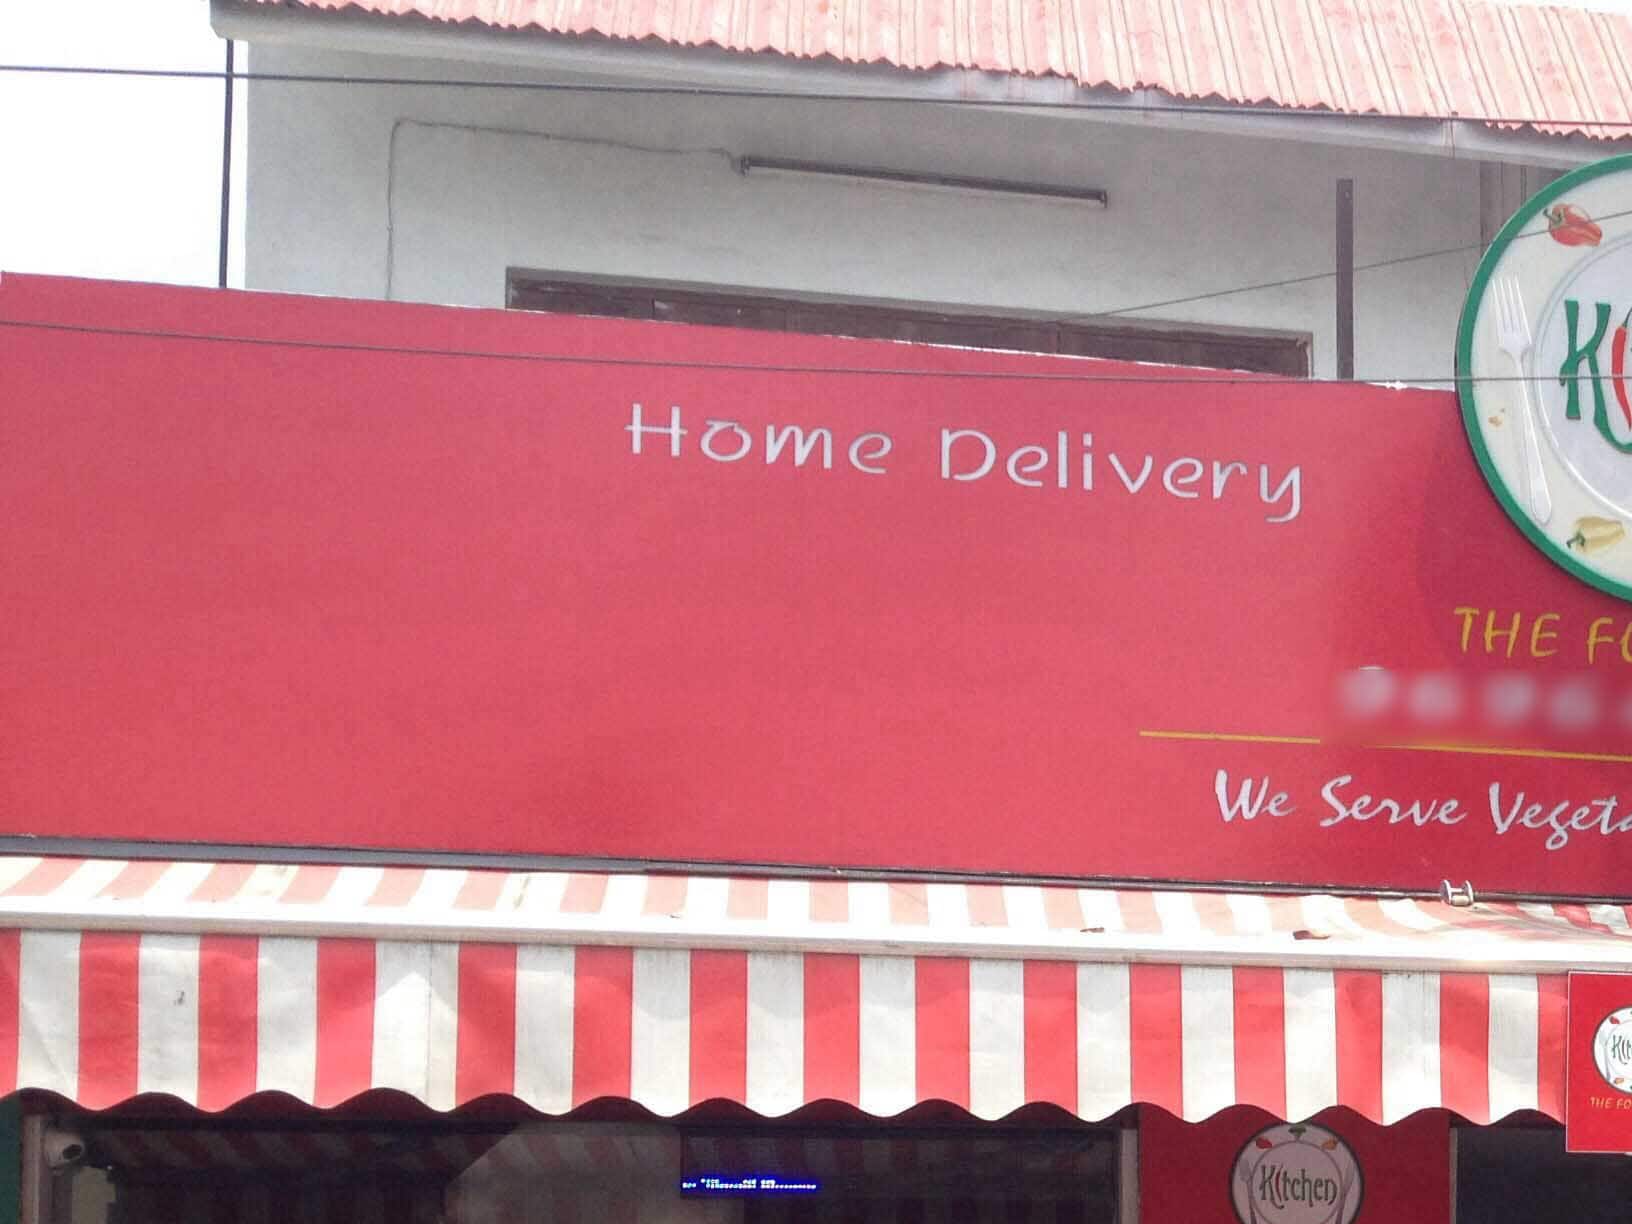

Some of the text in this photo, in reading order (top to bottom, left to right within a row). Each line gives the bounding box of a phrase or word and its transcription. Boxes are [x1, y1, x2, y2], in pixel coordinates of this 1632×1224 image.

[625, 403, 1303, 523] Home Delivery
[1454, 606, 1563, 658] THE
[1213, 769, 1298, 824] We
[1319, 773, 1468, 830] Serve
[1590, 1097, 1614, 1109] THE
[1259, 1162, 1338, 1209] Kitchen
